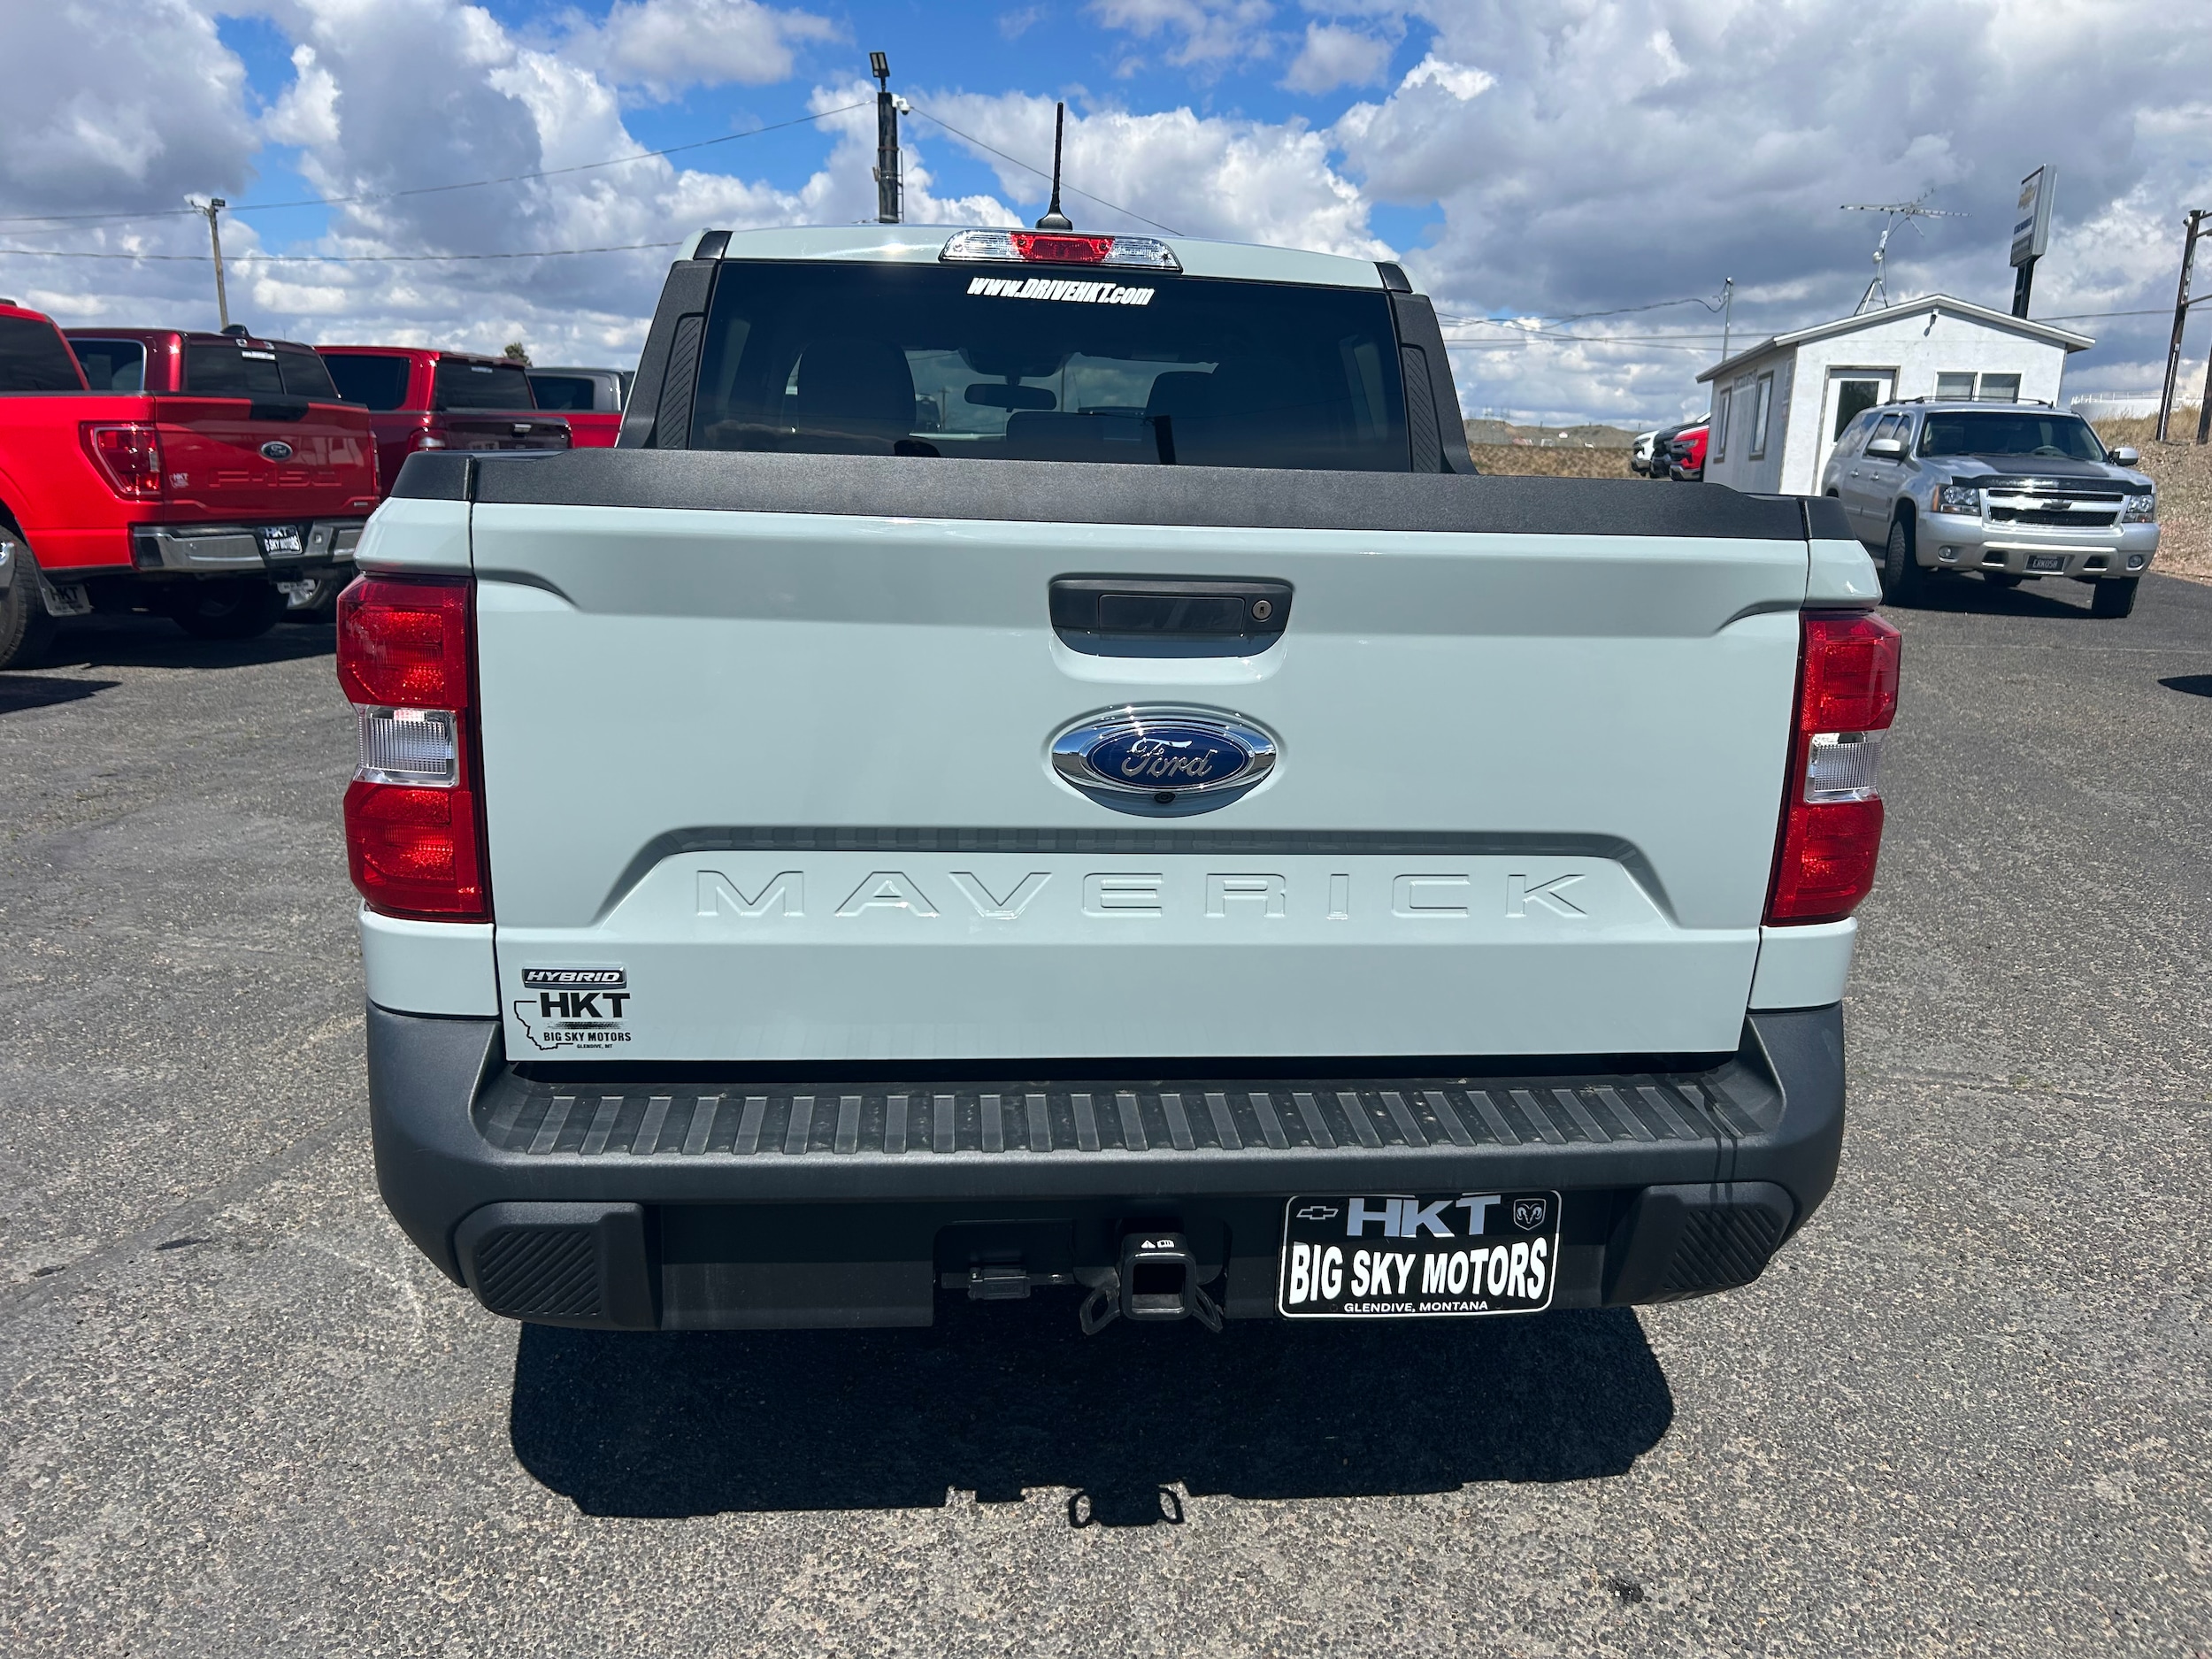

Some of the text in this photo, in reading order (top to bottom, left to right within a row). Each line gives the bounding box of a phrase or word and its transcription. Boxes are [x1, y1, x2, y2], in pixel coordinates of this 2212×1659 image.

[966, 277, 1155, 306] www.DRIVEHKT.com
[1121, 738, 1218, 777] Ford
[695, 871, 1589, 919] MAVERICK
[526, 971, 620, 982] HYBRID
[540, 992, 631, 1018] HKT
[543, 1032, 632, 1041] BIG SKY MOTORS
[1346, 1194, 1502, 1238] HKT
[1289, 1236, 1548, 1305] BIG SKY MOTORS
[1344, 1301, 1488, 1314] GLENDIVE, MONTANA
